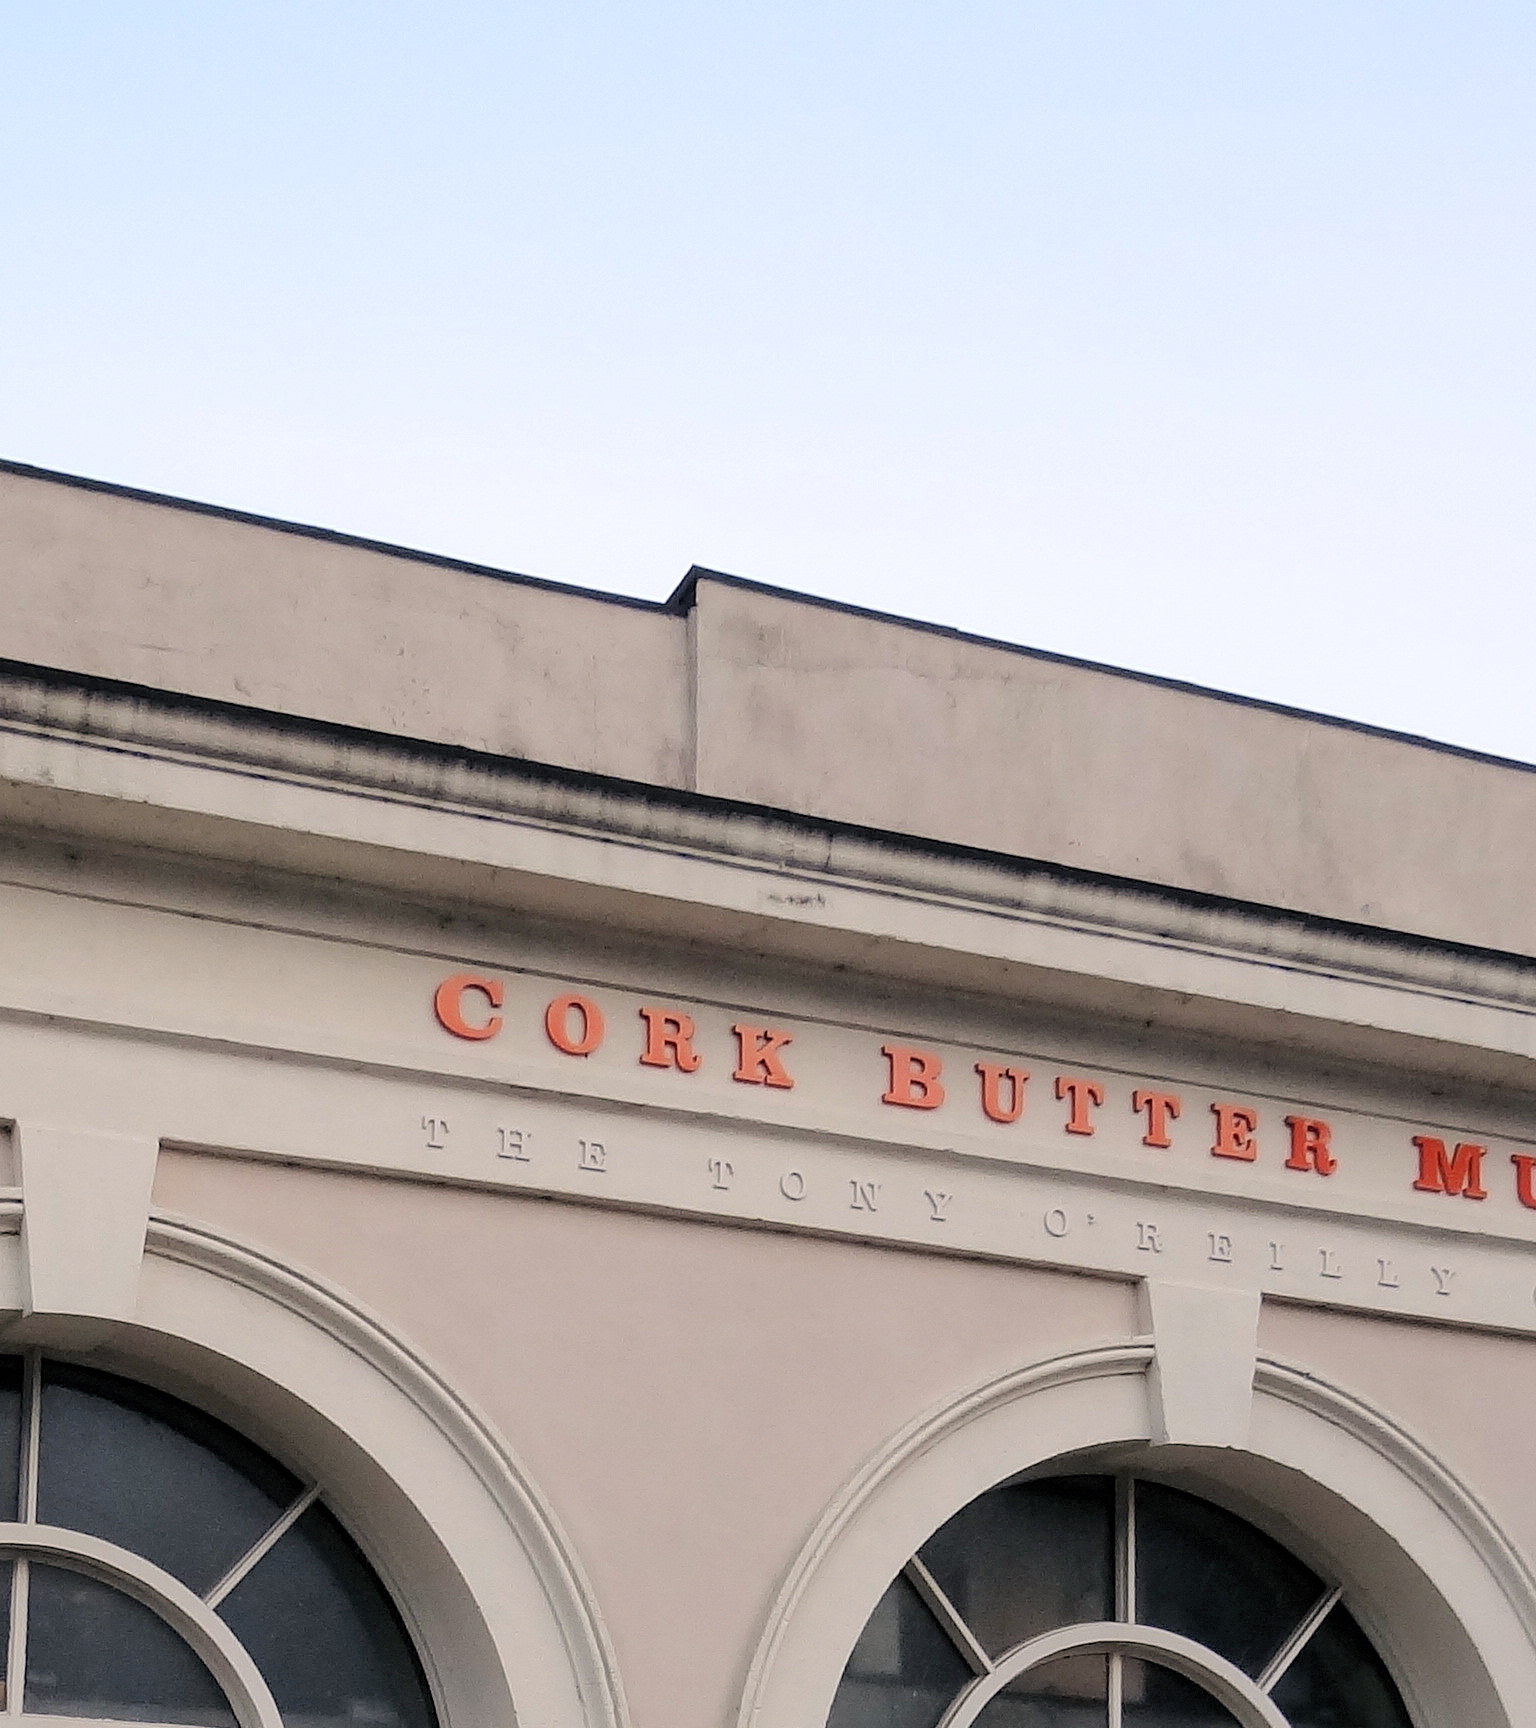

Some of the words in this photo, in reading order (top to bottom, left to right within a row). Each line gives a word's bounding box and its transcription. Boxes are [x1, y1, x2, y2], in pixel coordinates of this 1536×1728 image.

[434, 972, 795, 1090] CORK
[880, 1045, 1338, 1177] BUTTER
[421, 1115, 607, 1173] THE
[707, 1156, 954, 1222] TONY
